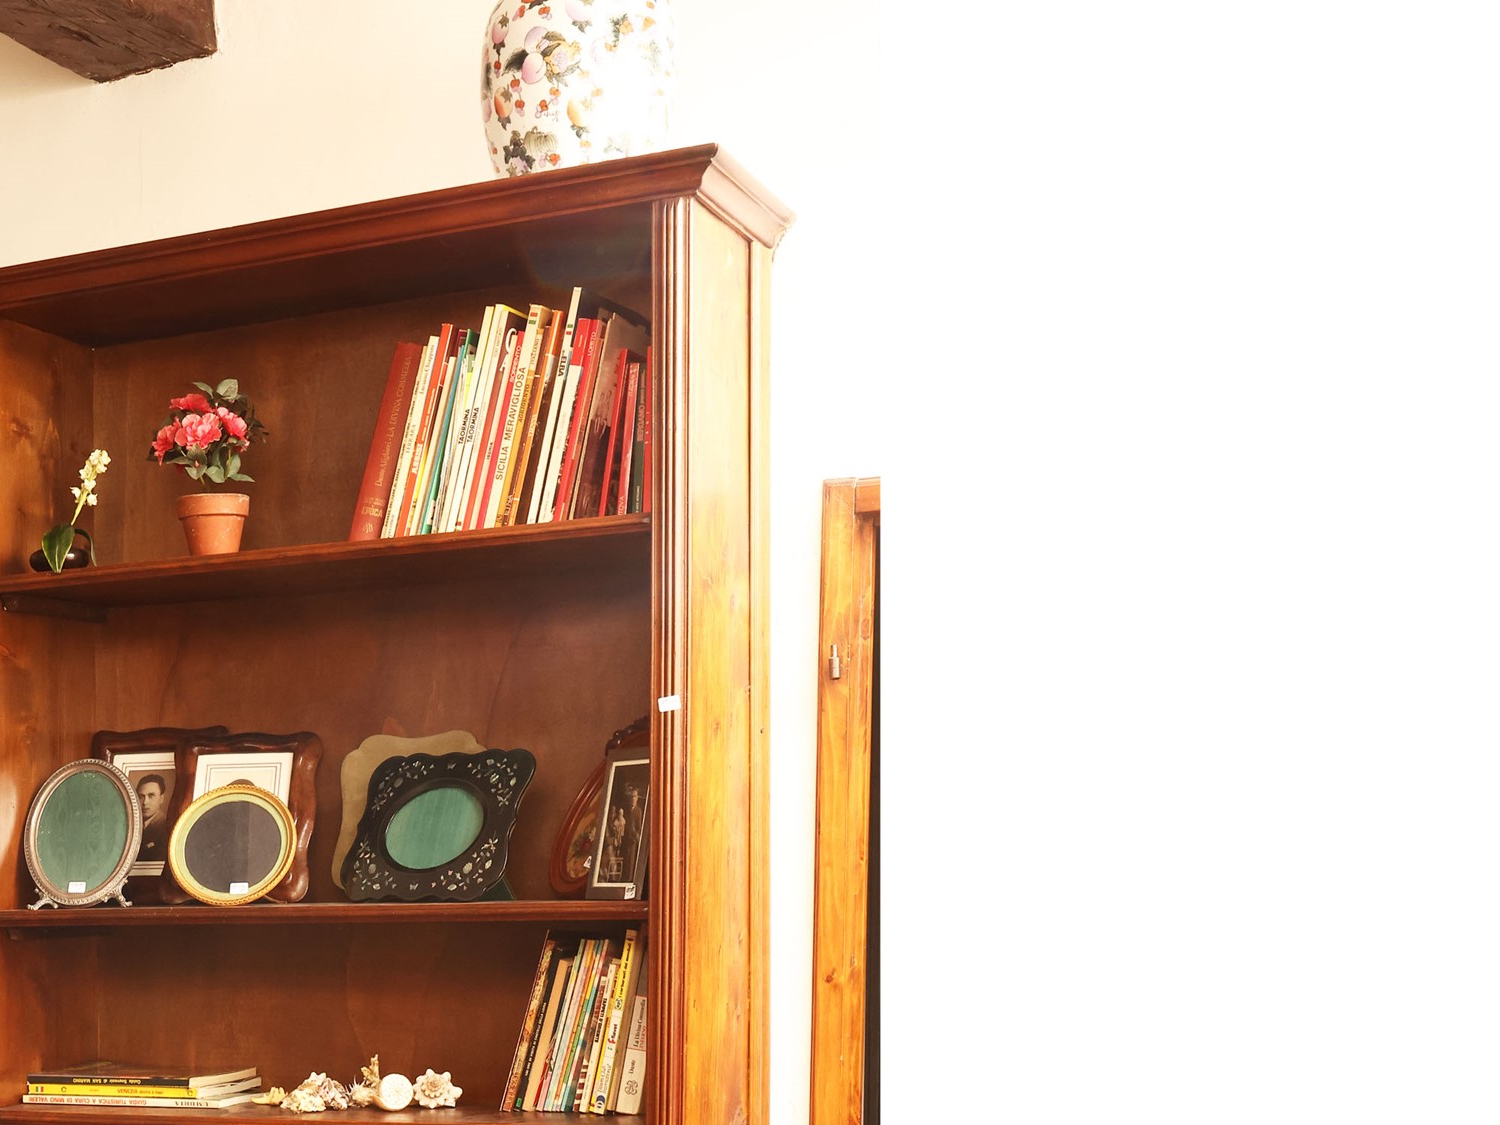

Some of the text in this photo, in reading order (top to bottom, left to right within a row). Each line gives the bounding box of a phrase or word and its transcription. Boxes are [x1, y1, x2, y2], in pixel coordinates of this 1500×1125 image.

[509, 345, 522, 383] SORRENTO
[389, 398, 404, 425] DIVINA
[518, 383, 531, 423] AGRIGENTO
[458, 408, 470, 445] TAORMINA
[467, 406, 480, 443] TAORMINA
[495, 366, 527, 481] SICILIA MERAVIGLIOSA
[379, 441, 394, 469] Alighieri
[375, 468, 388, 487] Dante
